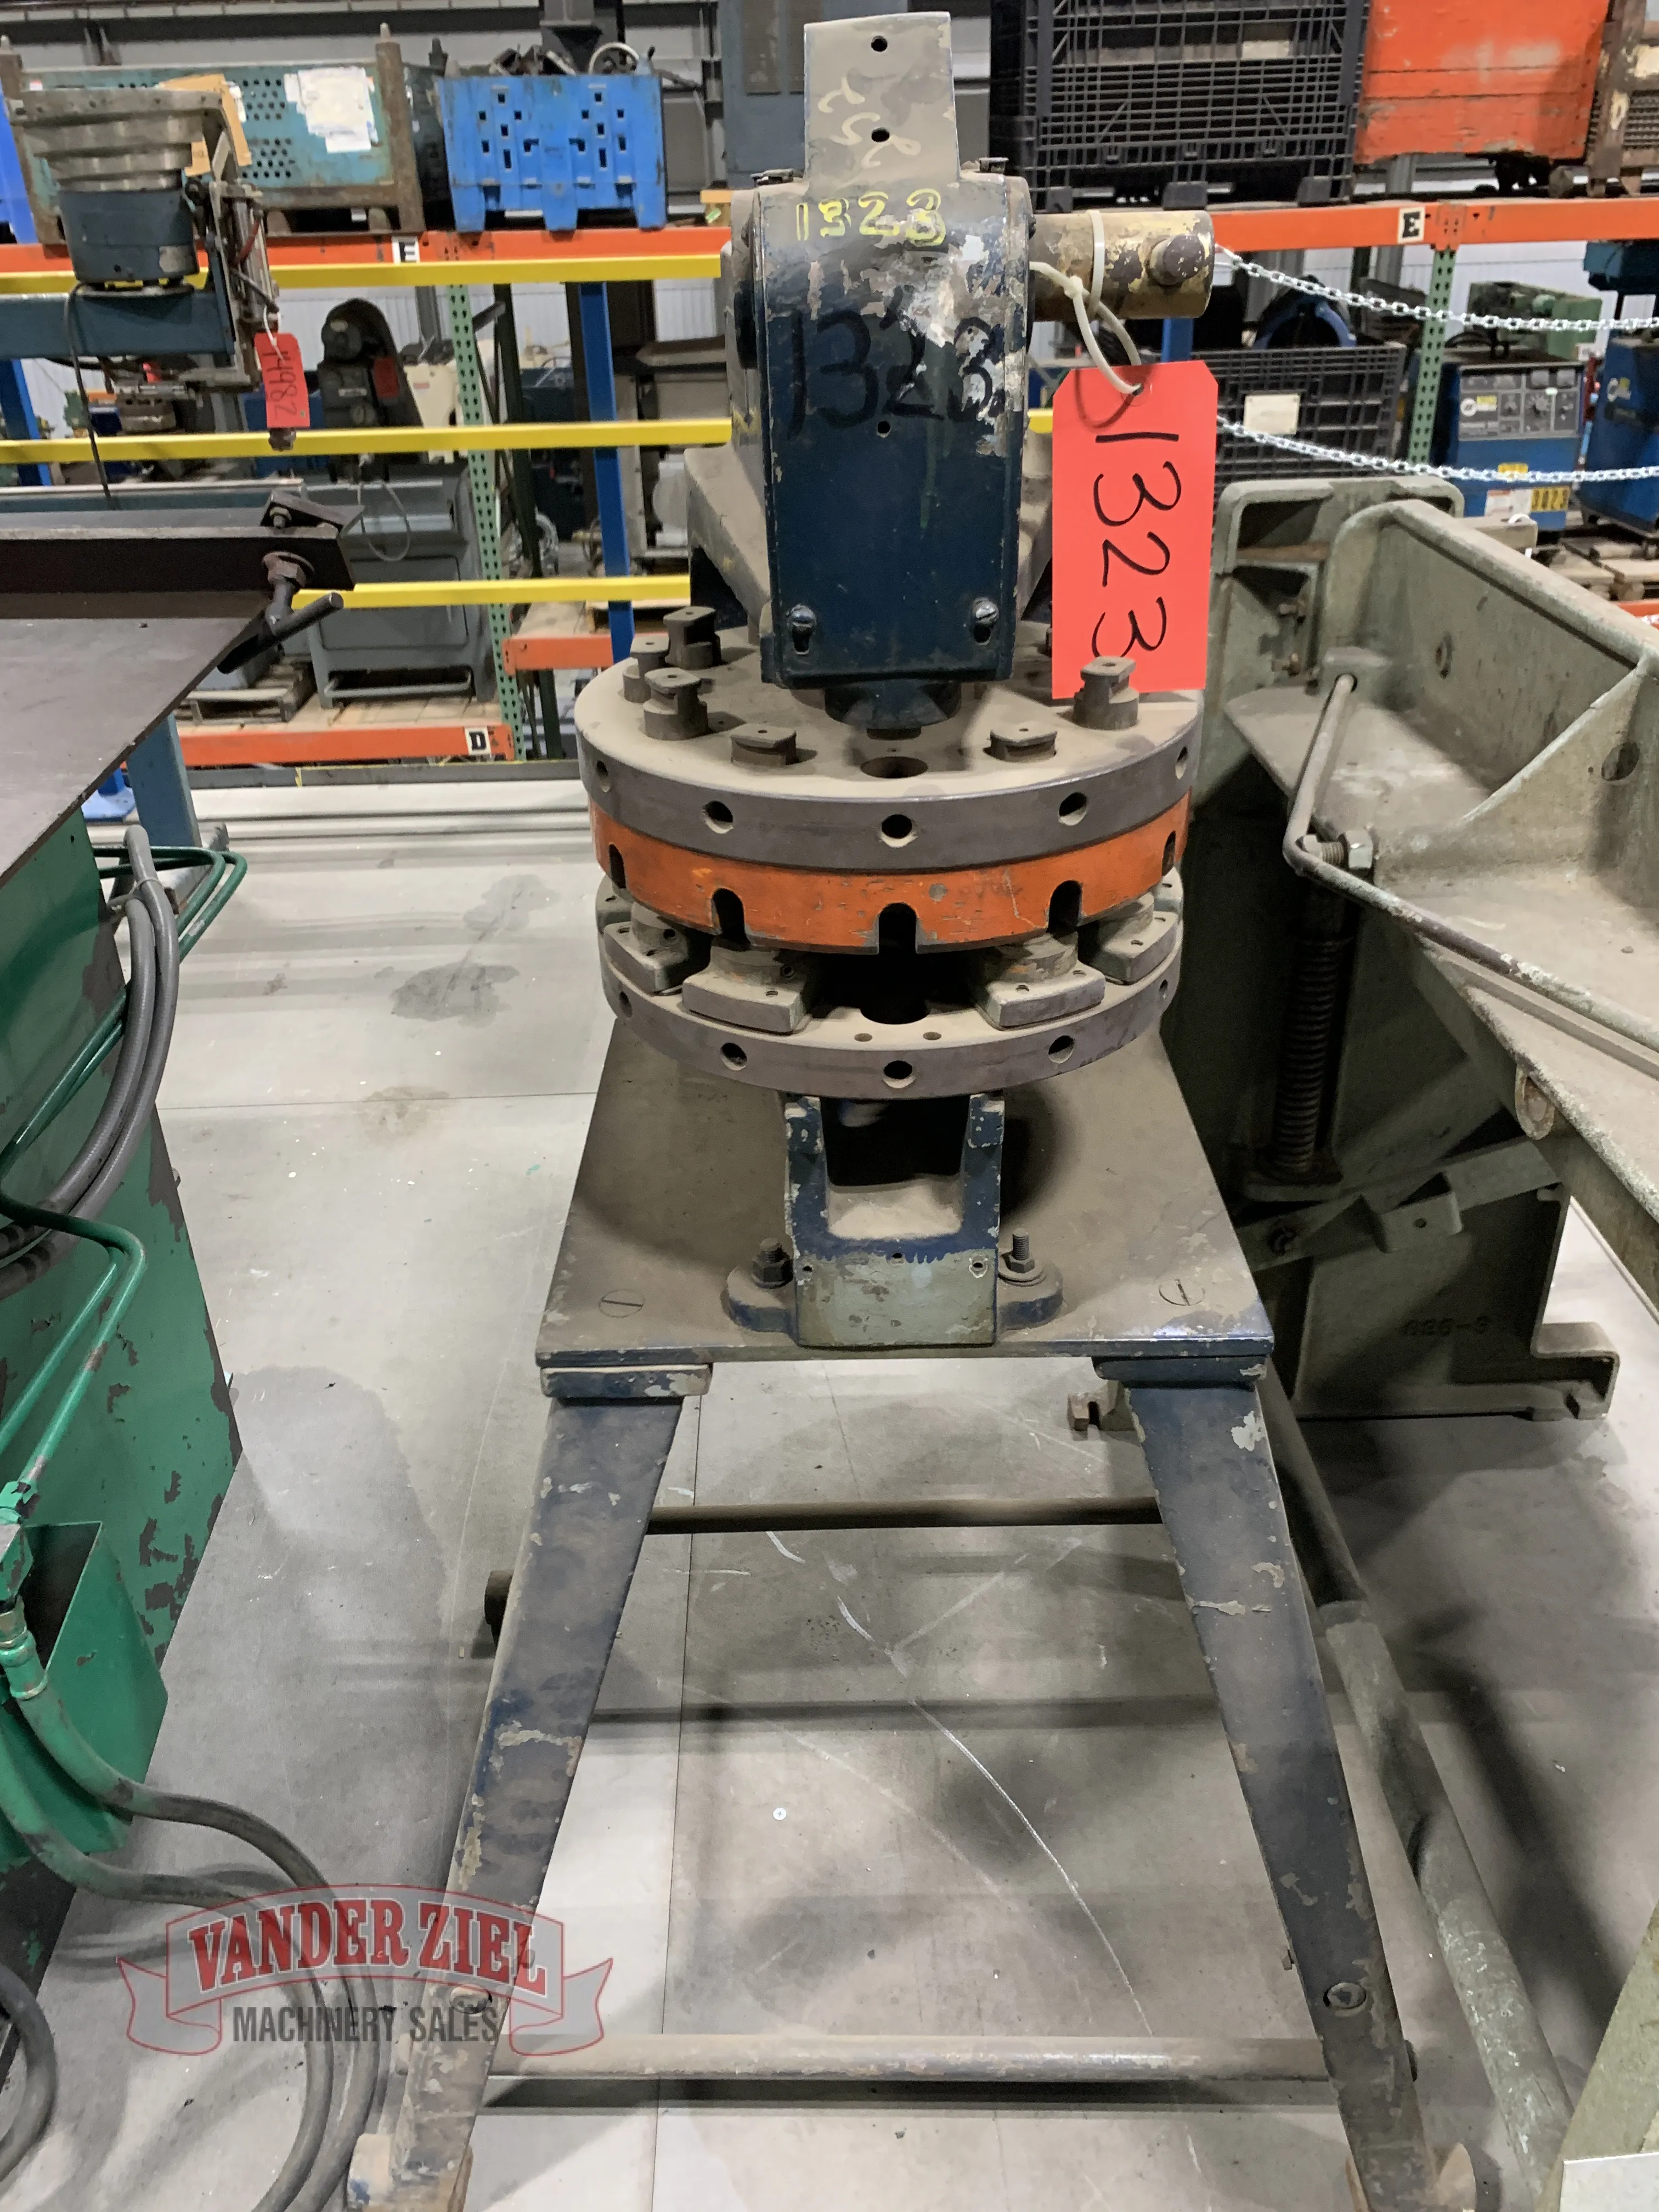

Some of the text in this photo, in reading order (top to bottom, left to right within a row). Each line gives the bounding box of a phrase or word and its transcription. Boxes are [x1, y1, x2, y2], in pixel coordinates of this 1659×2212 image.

[1402, 211, 1420, 238] E
[1092, 431, 1182, 658] 1323
[469, 731, 487, 751] D
